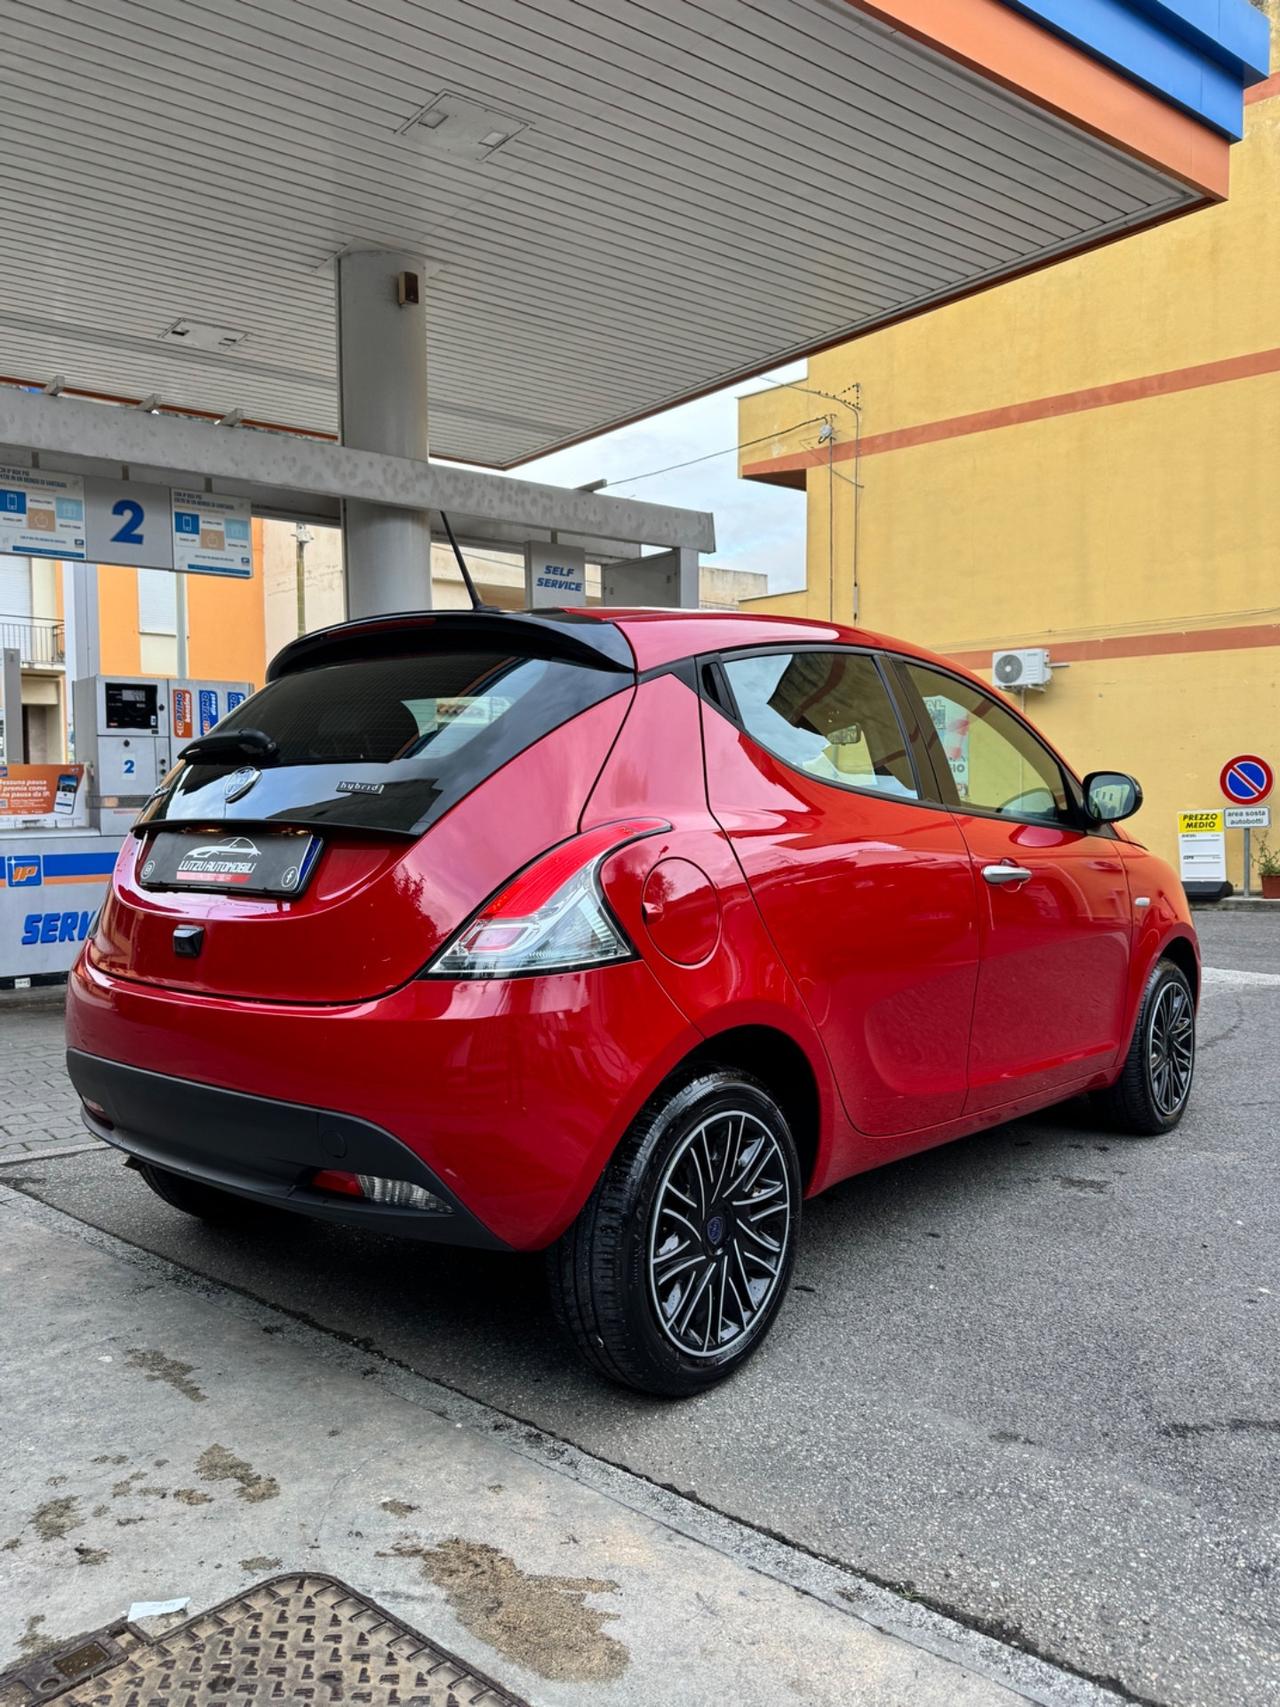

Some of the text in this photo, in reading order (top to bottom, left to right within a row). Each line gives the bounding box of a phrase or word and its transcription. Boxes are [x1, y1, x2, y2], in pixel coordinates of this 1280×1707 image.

[110, 499, 145, 545] 2
[544, 565, 575, 577] SELF
[536, 577, 583, 592] SERVICE
[123, 759, 135, 774] 2
[340, 781, 380, 791] hybrid
[1182, 813, 1218, 821] PREZZO
[1185, 821, 1216, 829] MEDIO
[204, 861, 257, 874] AUTOMOBILI
